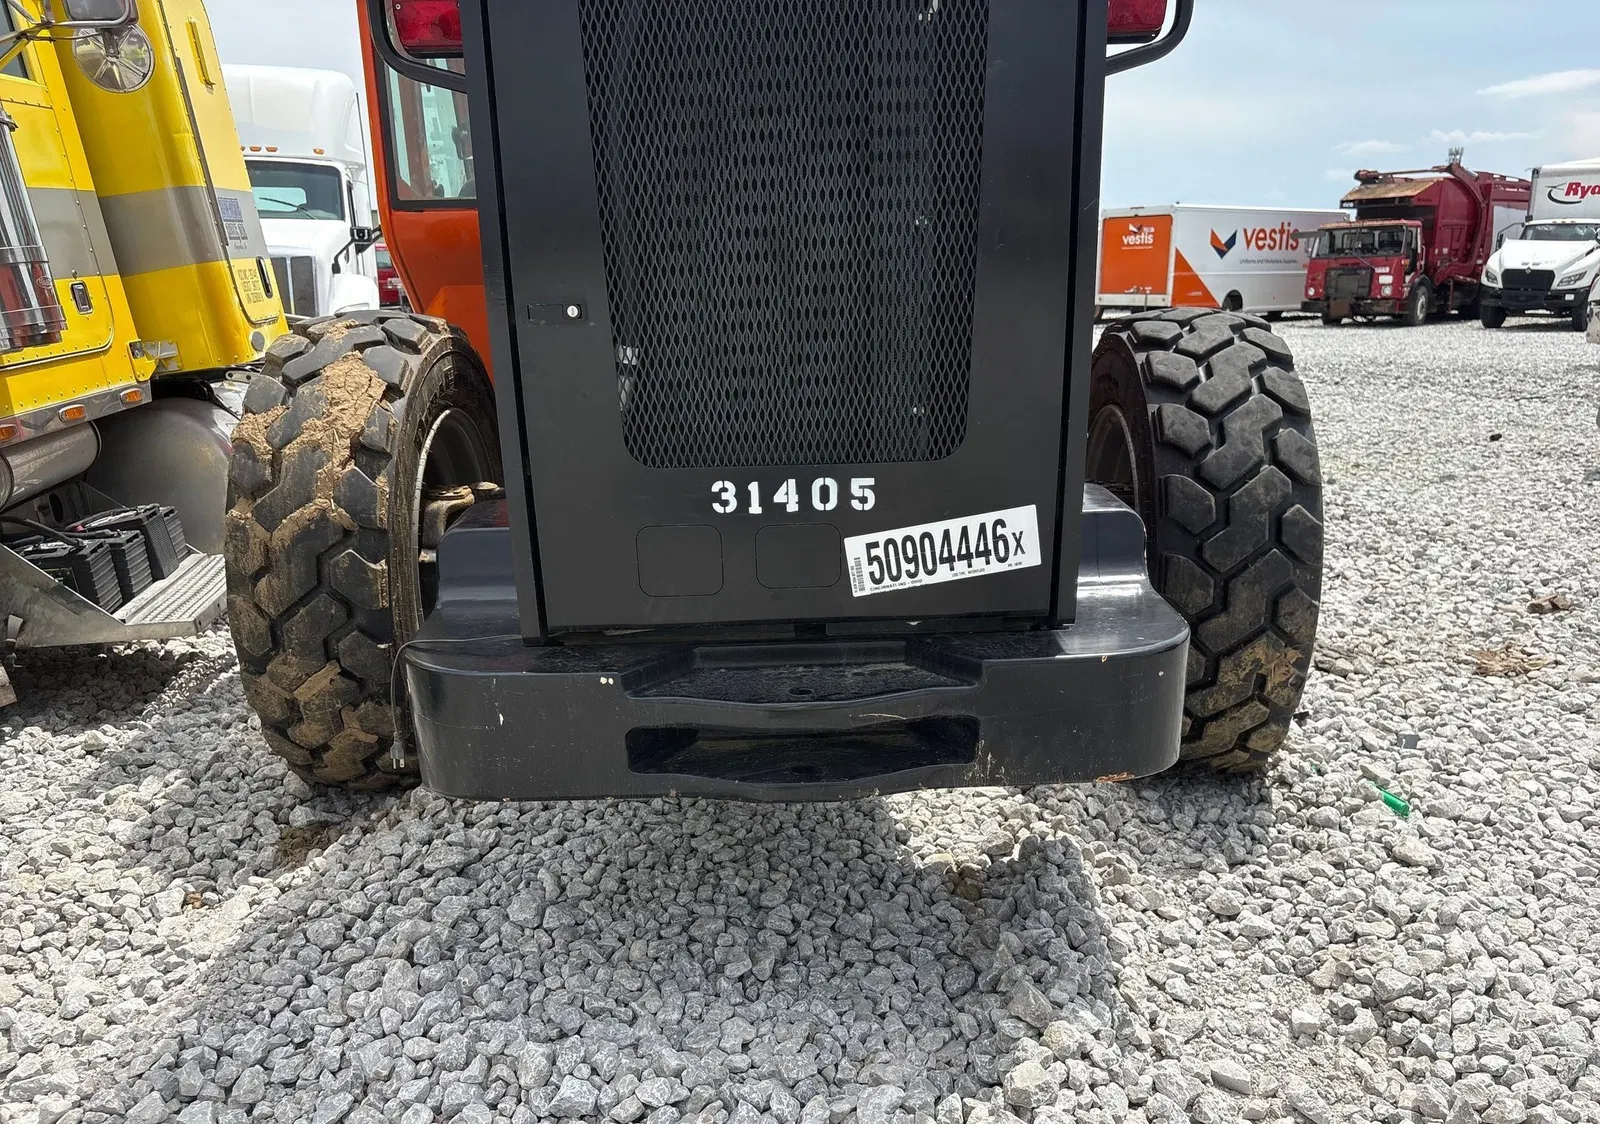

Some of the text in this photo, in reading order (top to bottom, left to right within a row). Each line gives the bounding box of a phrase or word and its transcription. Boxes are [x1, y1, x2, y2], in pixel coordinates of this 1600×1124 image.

[1122, 232, 1154, 245] vestis
[1243, 221, 1300, 251] vestis
[711, 477, 876, 514] 31405
[870, 584, 897, 592] CINCINNATI
